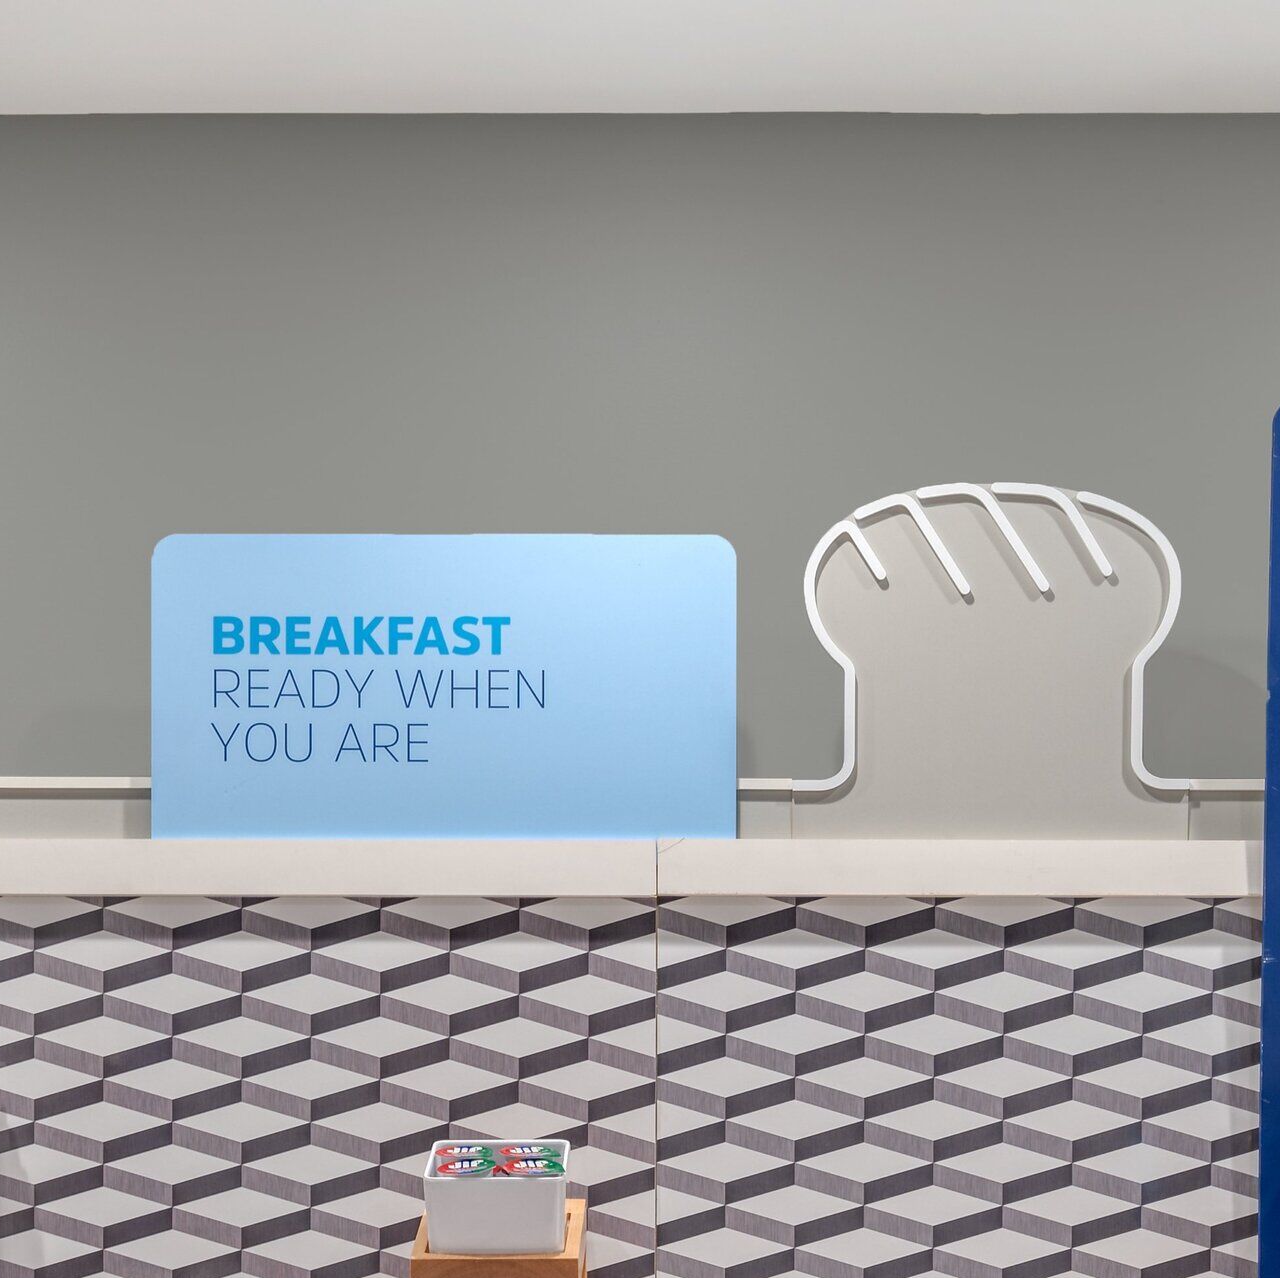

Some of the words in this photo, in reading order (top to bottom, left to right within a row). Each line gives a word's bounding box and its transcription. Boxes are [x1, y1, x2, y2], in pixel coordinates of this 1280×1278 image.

[212, 615, 511, 656] BREAKFAST
[213, 669, 375, 709] READY
[394, 669, 546, 709] WHEN
[210, 722, 313, 763] YOU
[335, 723, 430, 763] ARE
